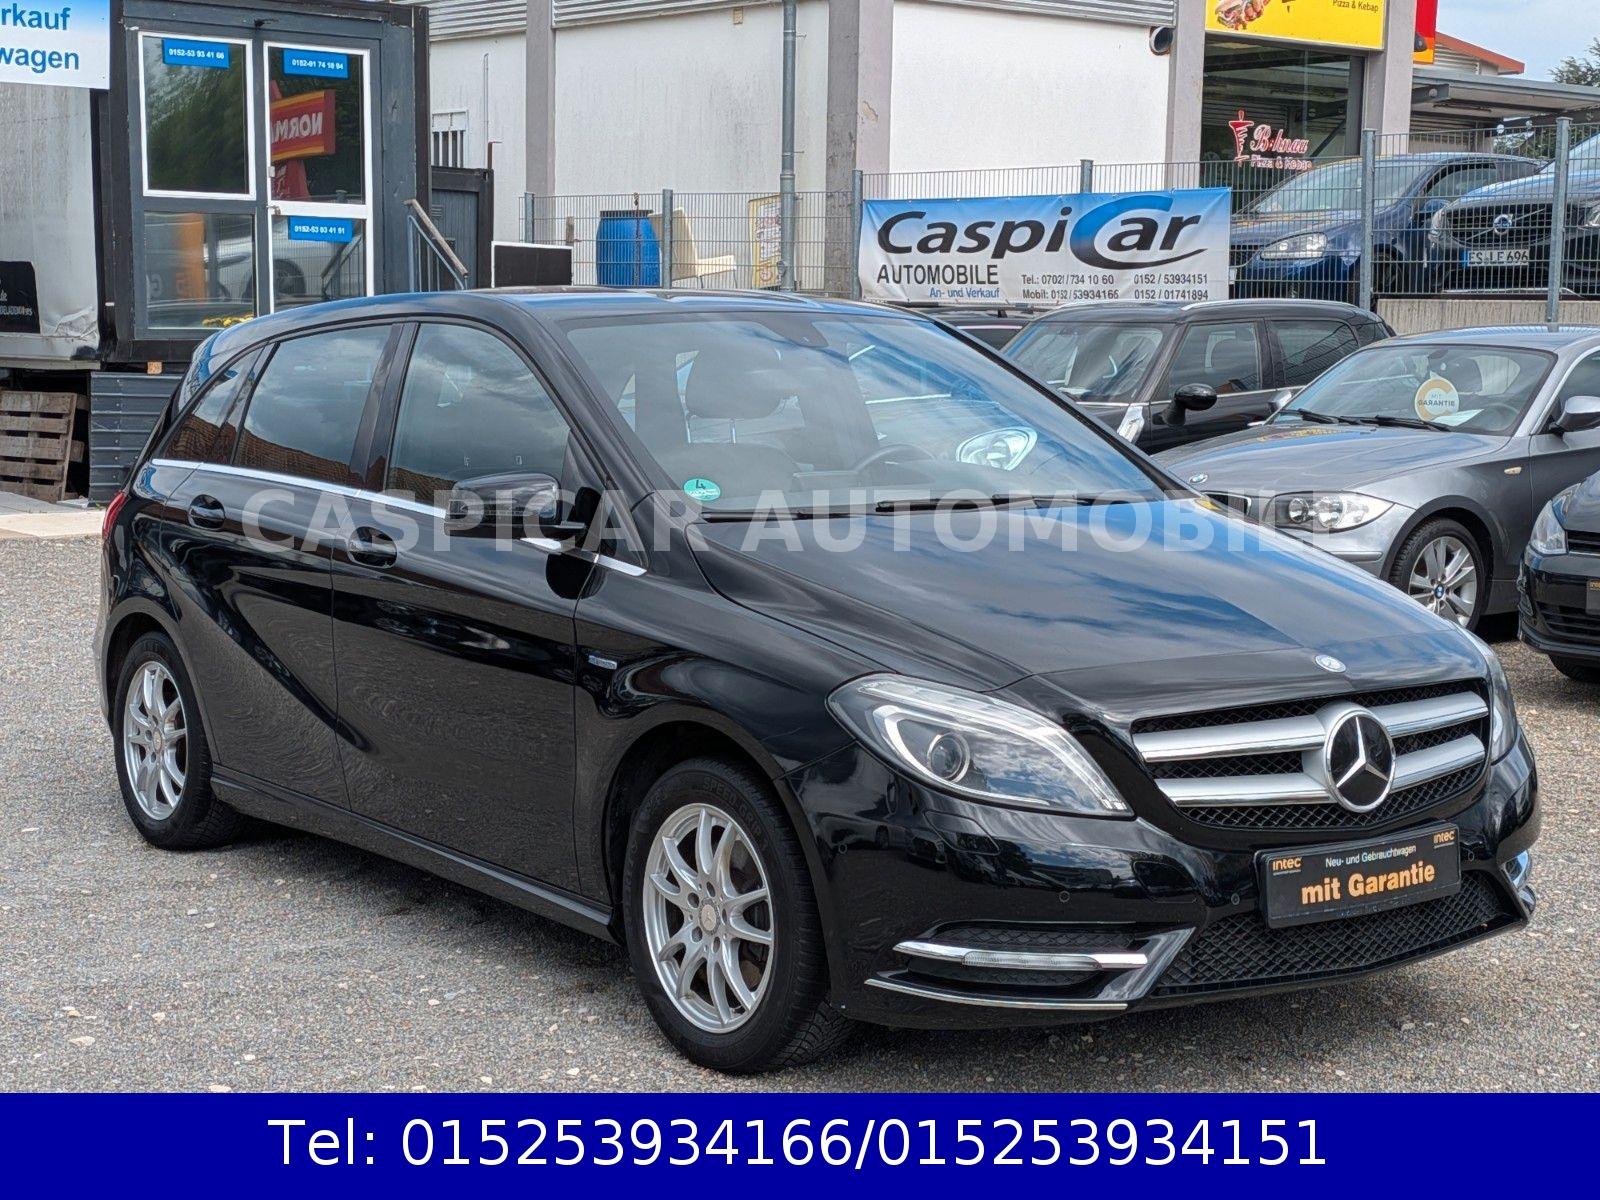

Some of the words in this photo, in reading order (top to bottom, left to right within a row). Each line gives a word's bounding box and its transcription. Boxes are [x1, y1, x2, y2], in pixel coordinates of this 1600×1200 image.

[1358, 2, 1379, 13] Kebap
[1, 3, 71, 30] rkauf
[876, 193, 1209, 271] CaspiCar
[1506, 250, 1529, 263] 696
[876, 264, 999, 285] AUTOMOBILE
[1088, 274, 1099, 285] 10
[1101, 274, 1115, 285] 60
[1134, 273, 1156, 285] 0152
[1163, 273, 1208, 284] 53934151
[929, 287, 945, 298] An-
[947, 287, 964, 298] und
[965, 286, 1000, 298] Verkauf
[1134, 289, 1156, 300] 0152
[1163, 289, 1209, 300] 01741894
[1417, 399, 1456, 407] GARANTIE
[1433, 830, 1456, 844] intec
[1325, 856, 1344, 868] Neu-
[1345, 852, 1360, 865] und
[1361, 844, 1417, 863] Gebrauchtwagen
[1272, 857, 1302, 873] intec
[1301, 877, 1341, 905] mit
[1348, 860, 1436, 898] Garantie
